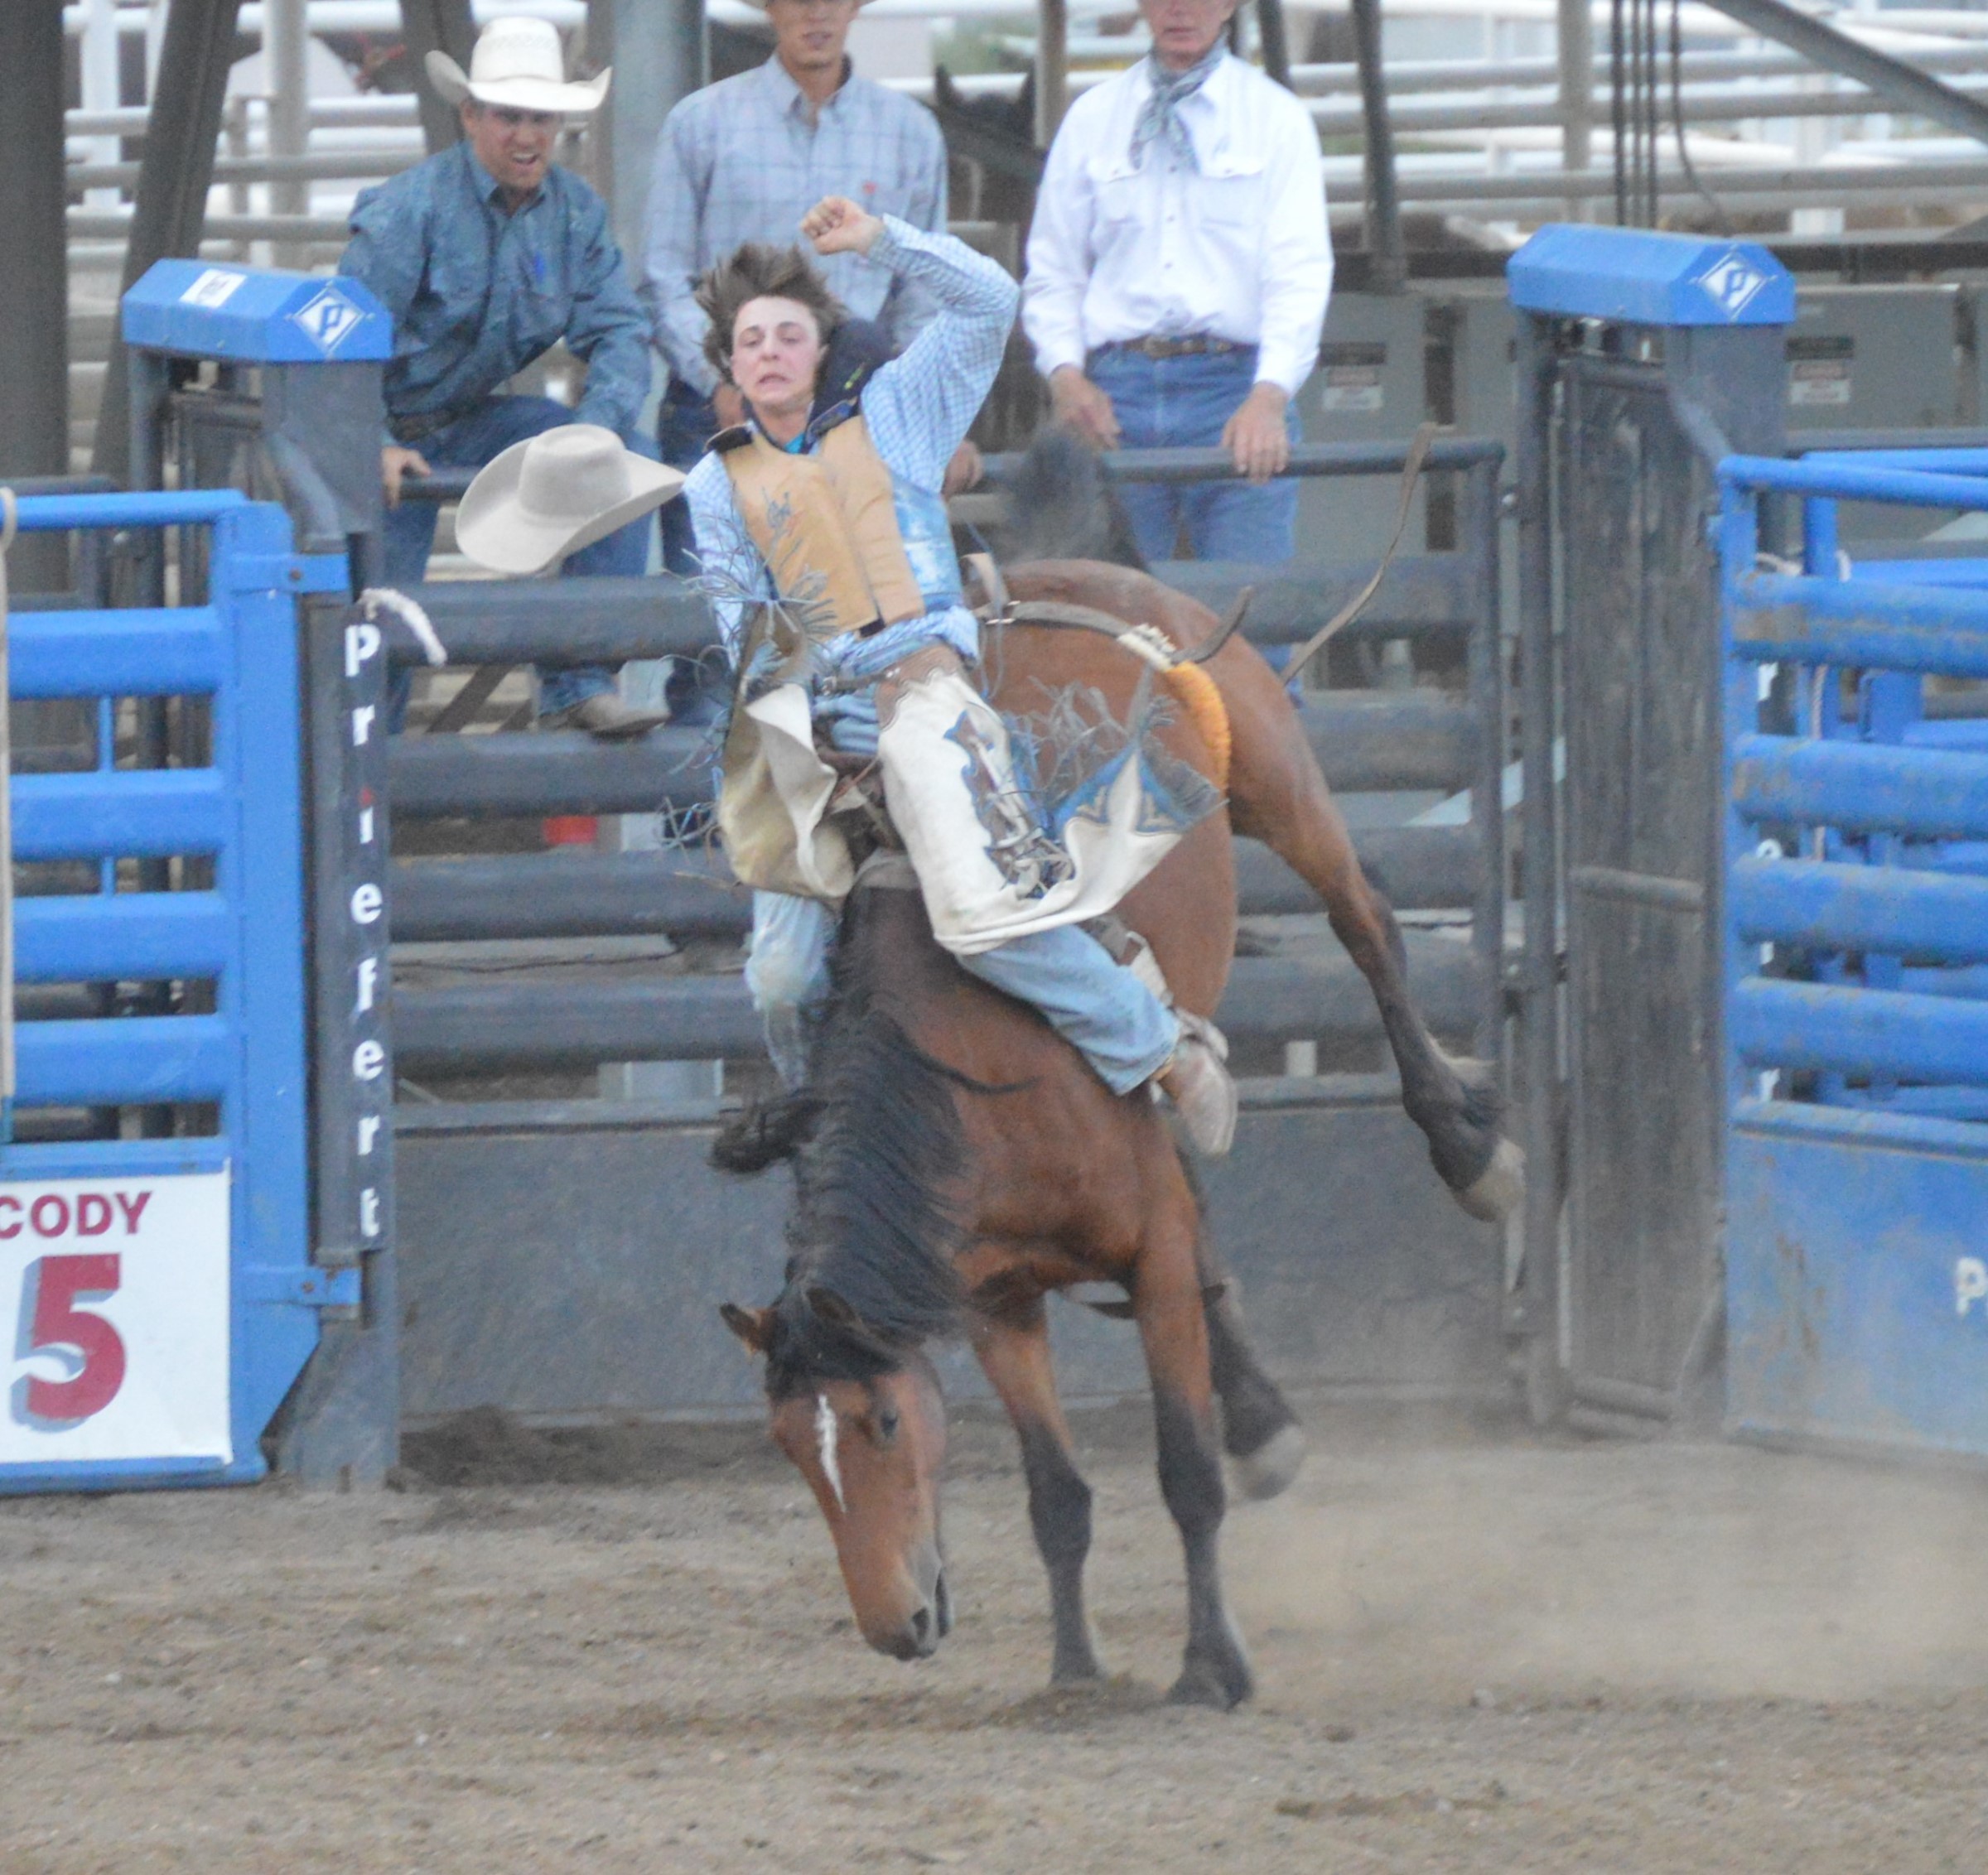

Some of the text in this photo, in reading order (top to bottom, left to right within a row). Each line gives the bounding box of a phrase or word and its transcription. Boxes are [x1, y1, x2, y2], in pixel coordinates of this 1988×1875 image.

[345, 624, 384, 1237] Priefert
[0, 1190, 152, 1240] CODY
[13, 1252, 128, 1430] 5
[1955, 1256, 1988, 1315] P
